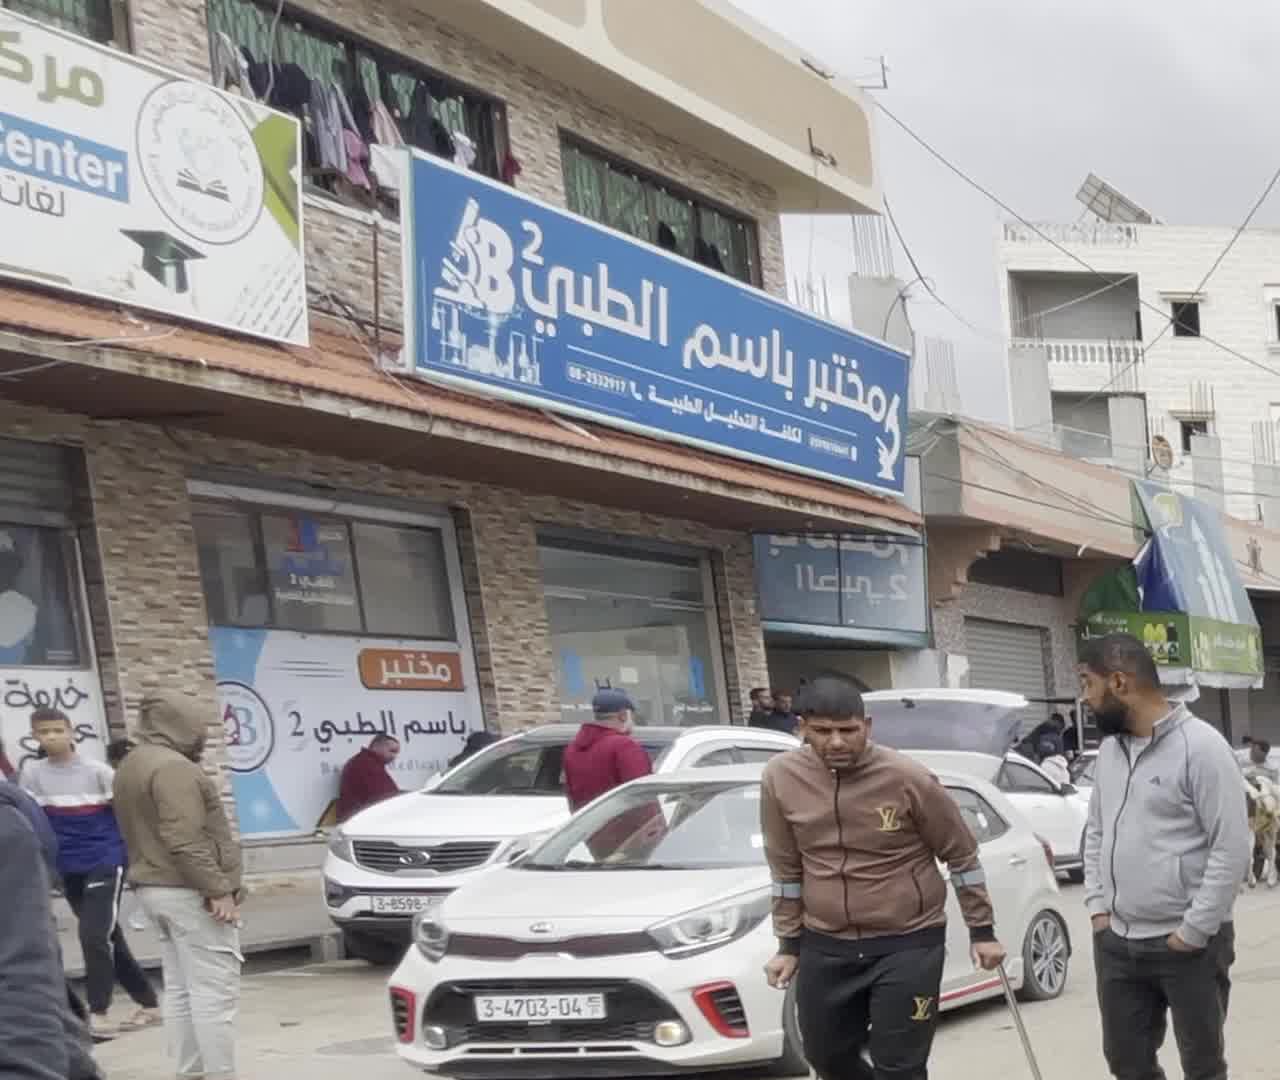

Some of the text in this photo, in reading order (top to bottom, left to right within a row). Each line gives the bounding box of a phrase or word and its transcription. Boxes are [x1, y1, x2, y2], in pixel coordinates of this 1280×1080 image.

[0, 31, 105, 107] مرك
[0, 120, 123, 193] enter
[521, 263, 886, 423] مختبر باسم الطبي
[381, 653, 452, 685] مختبر
[313, 710, 396, 752] الطبي
[403, 711, 467, 745] باسم
[483, 997, 582, 1018] 3-4703-04
